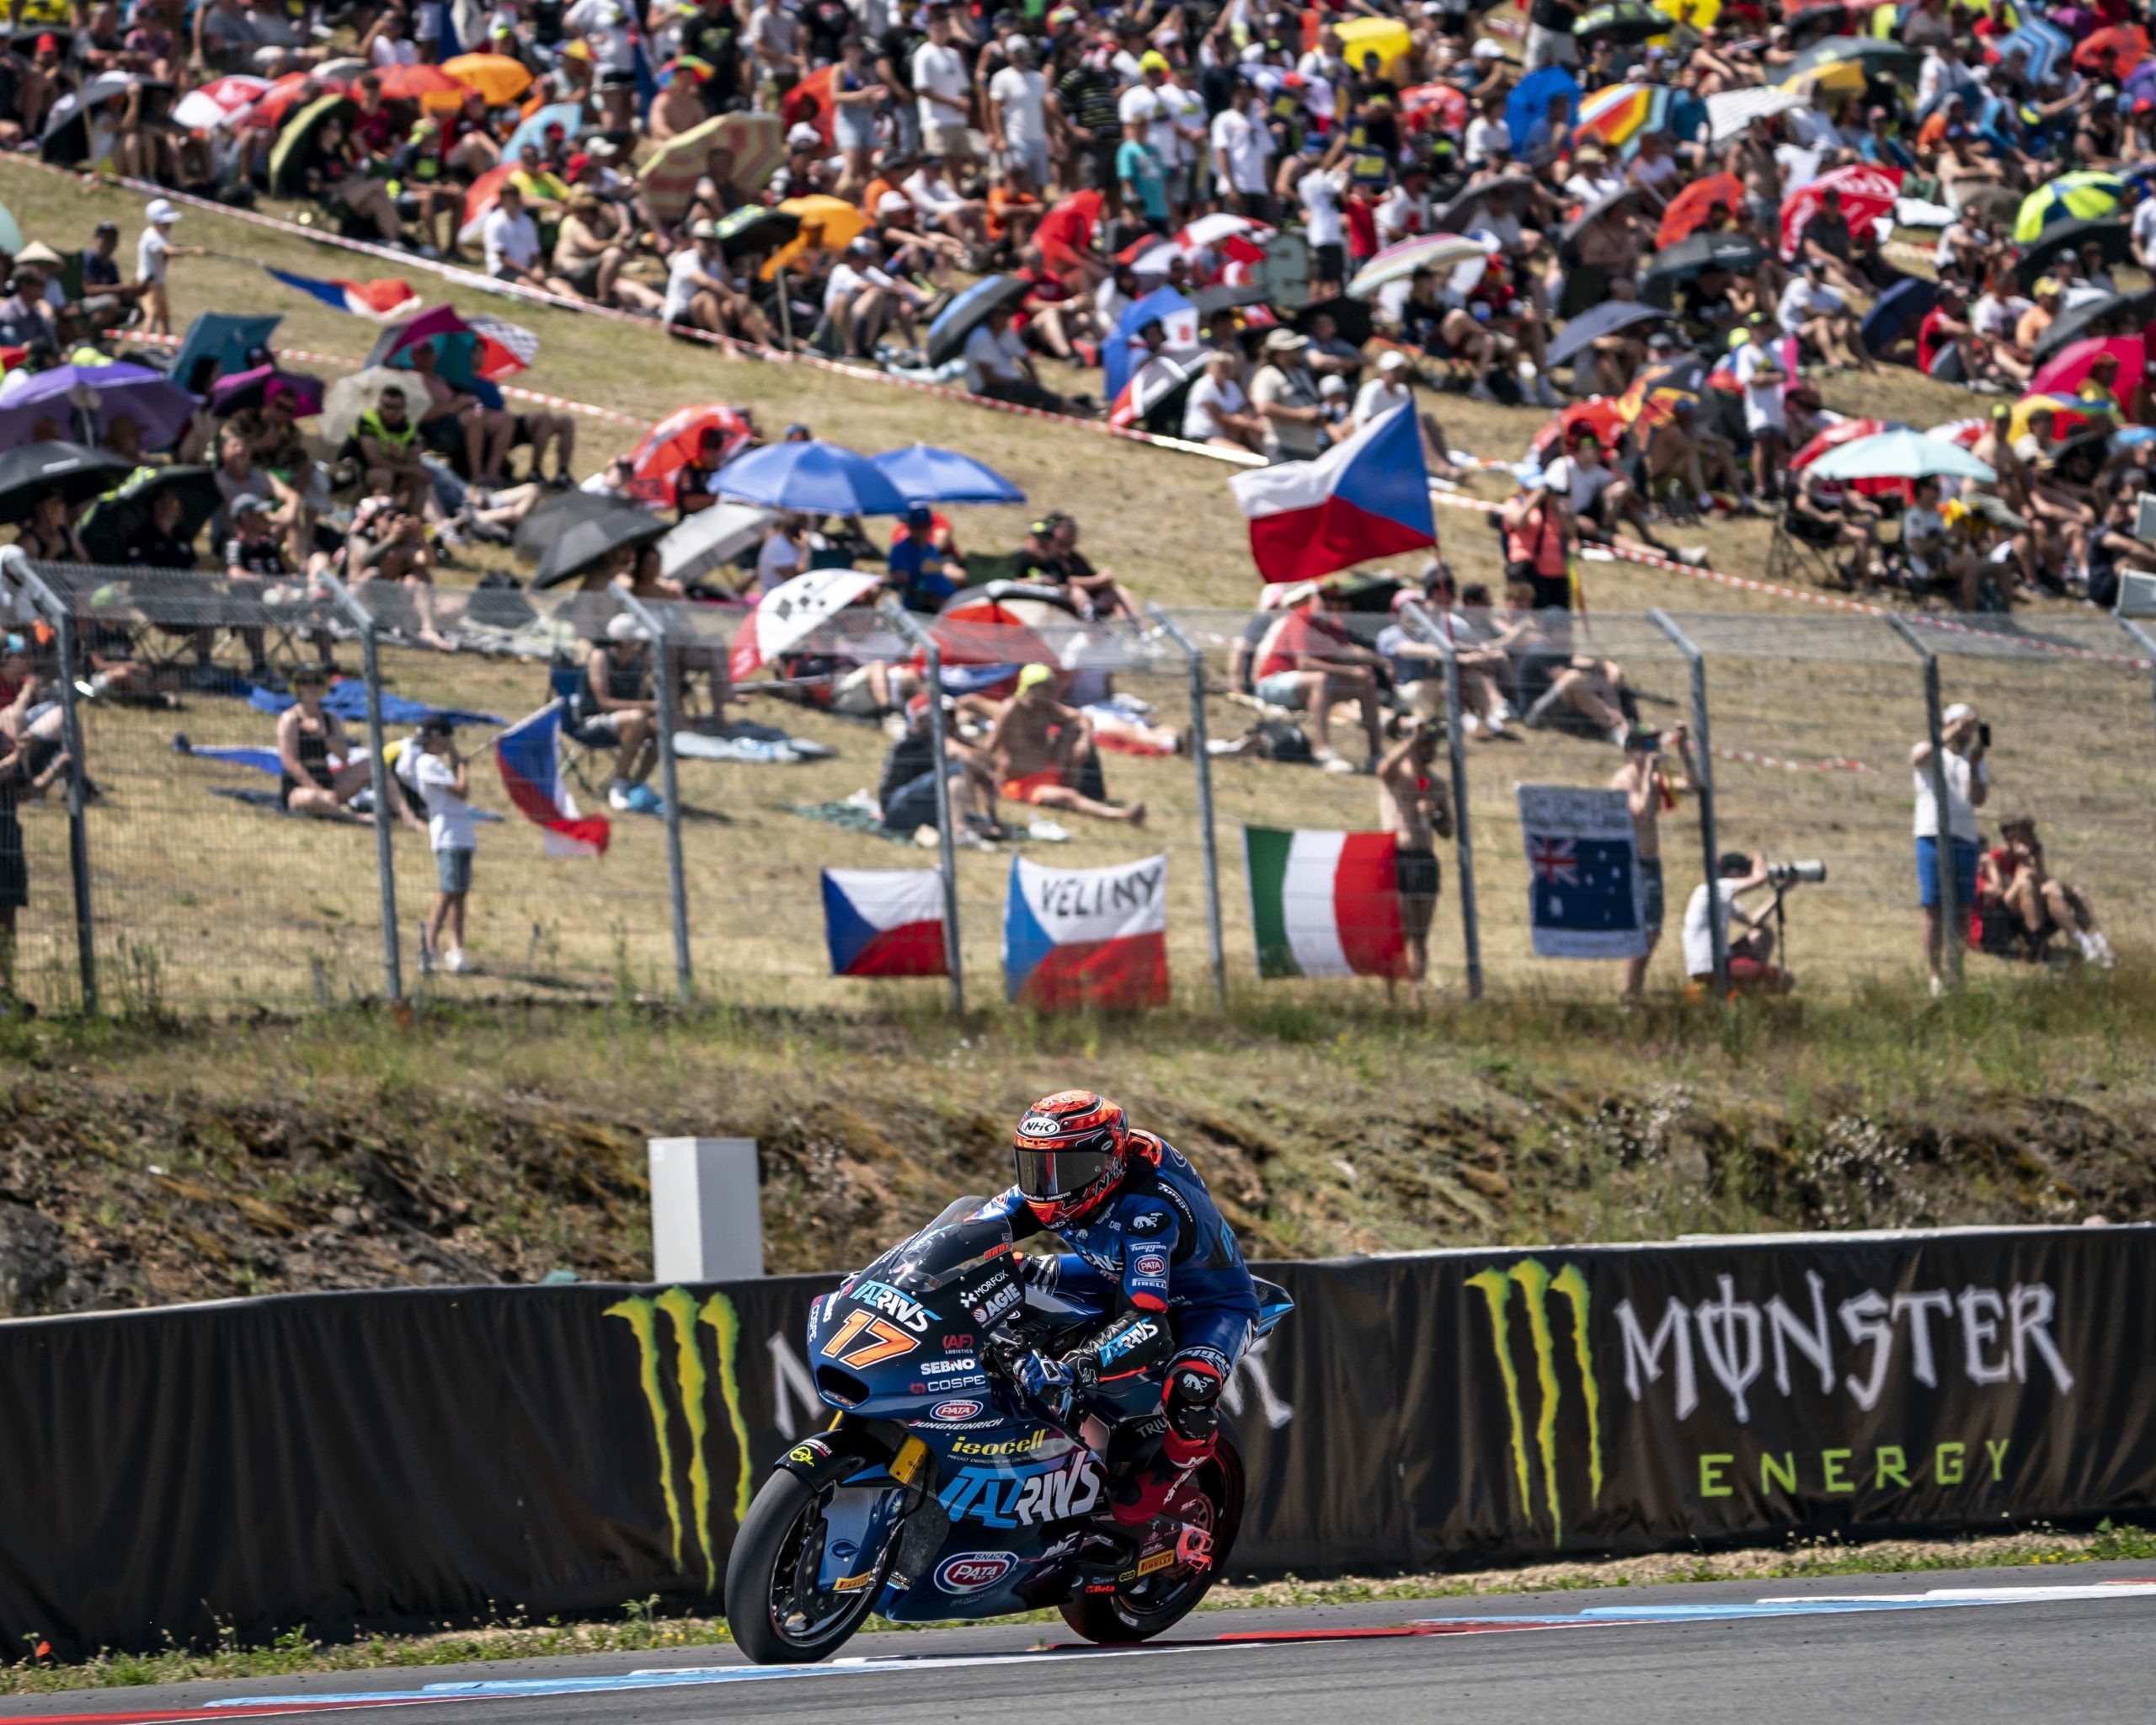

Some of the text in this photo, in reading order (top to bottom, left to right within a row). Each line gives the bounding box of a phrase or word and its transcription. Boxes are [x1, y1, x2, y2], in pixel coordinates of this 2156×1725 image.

[1140, 1261, 1161, 1270] PATA
[974, 1269, 1009, 1297] MORFOX
[985, 1283, 1021, 1317] AGIE
[821, 1308, 921, 1370] 17
[1614, 1270, 2074, 1423] MONSTER
[927, 1375, 986, 1391] COSPE
[941, 1406, 972, 1415] PATA
[909, 1418, 1005, 1430] JUNGHEINRICH
[1136, 1416, 1168, 1438] TRIU
[952, 1429, 1046, 1455] isocell
[947, 1454, 969, 1462] PRECAST
[1699, 1439, 2009, 1498] ENERGY
[952, 1564, 1000, 1581] PATA
[1140, 1553, 1172, 1573] PIRELLI
